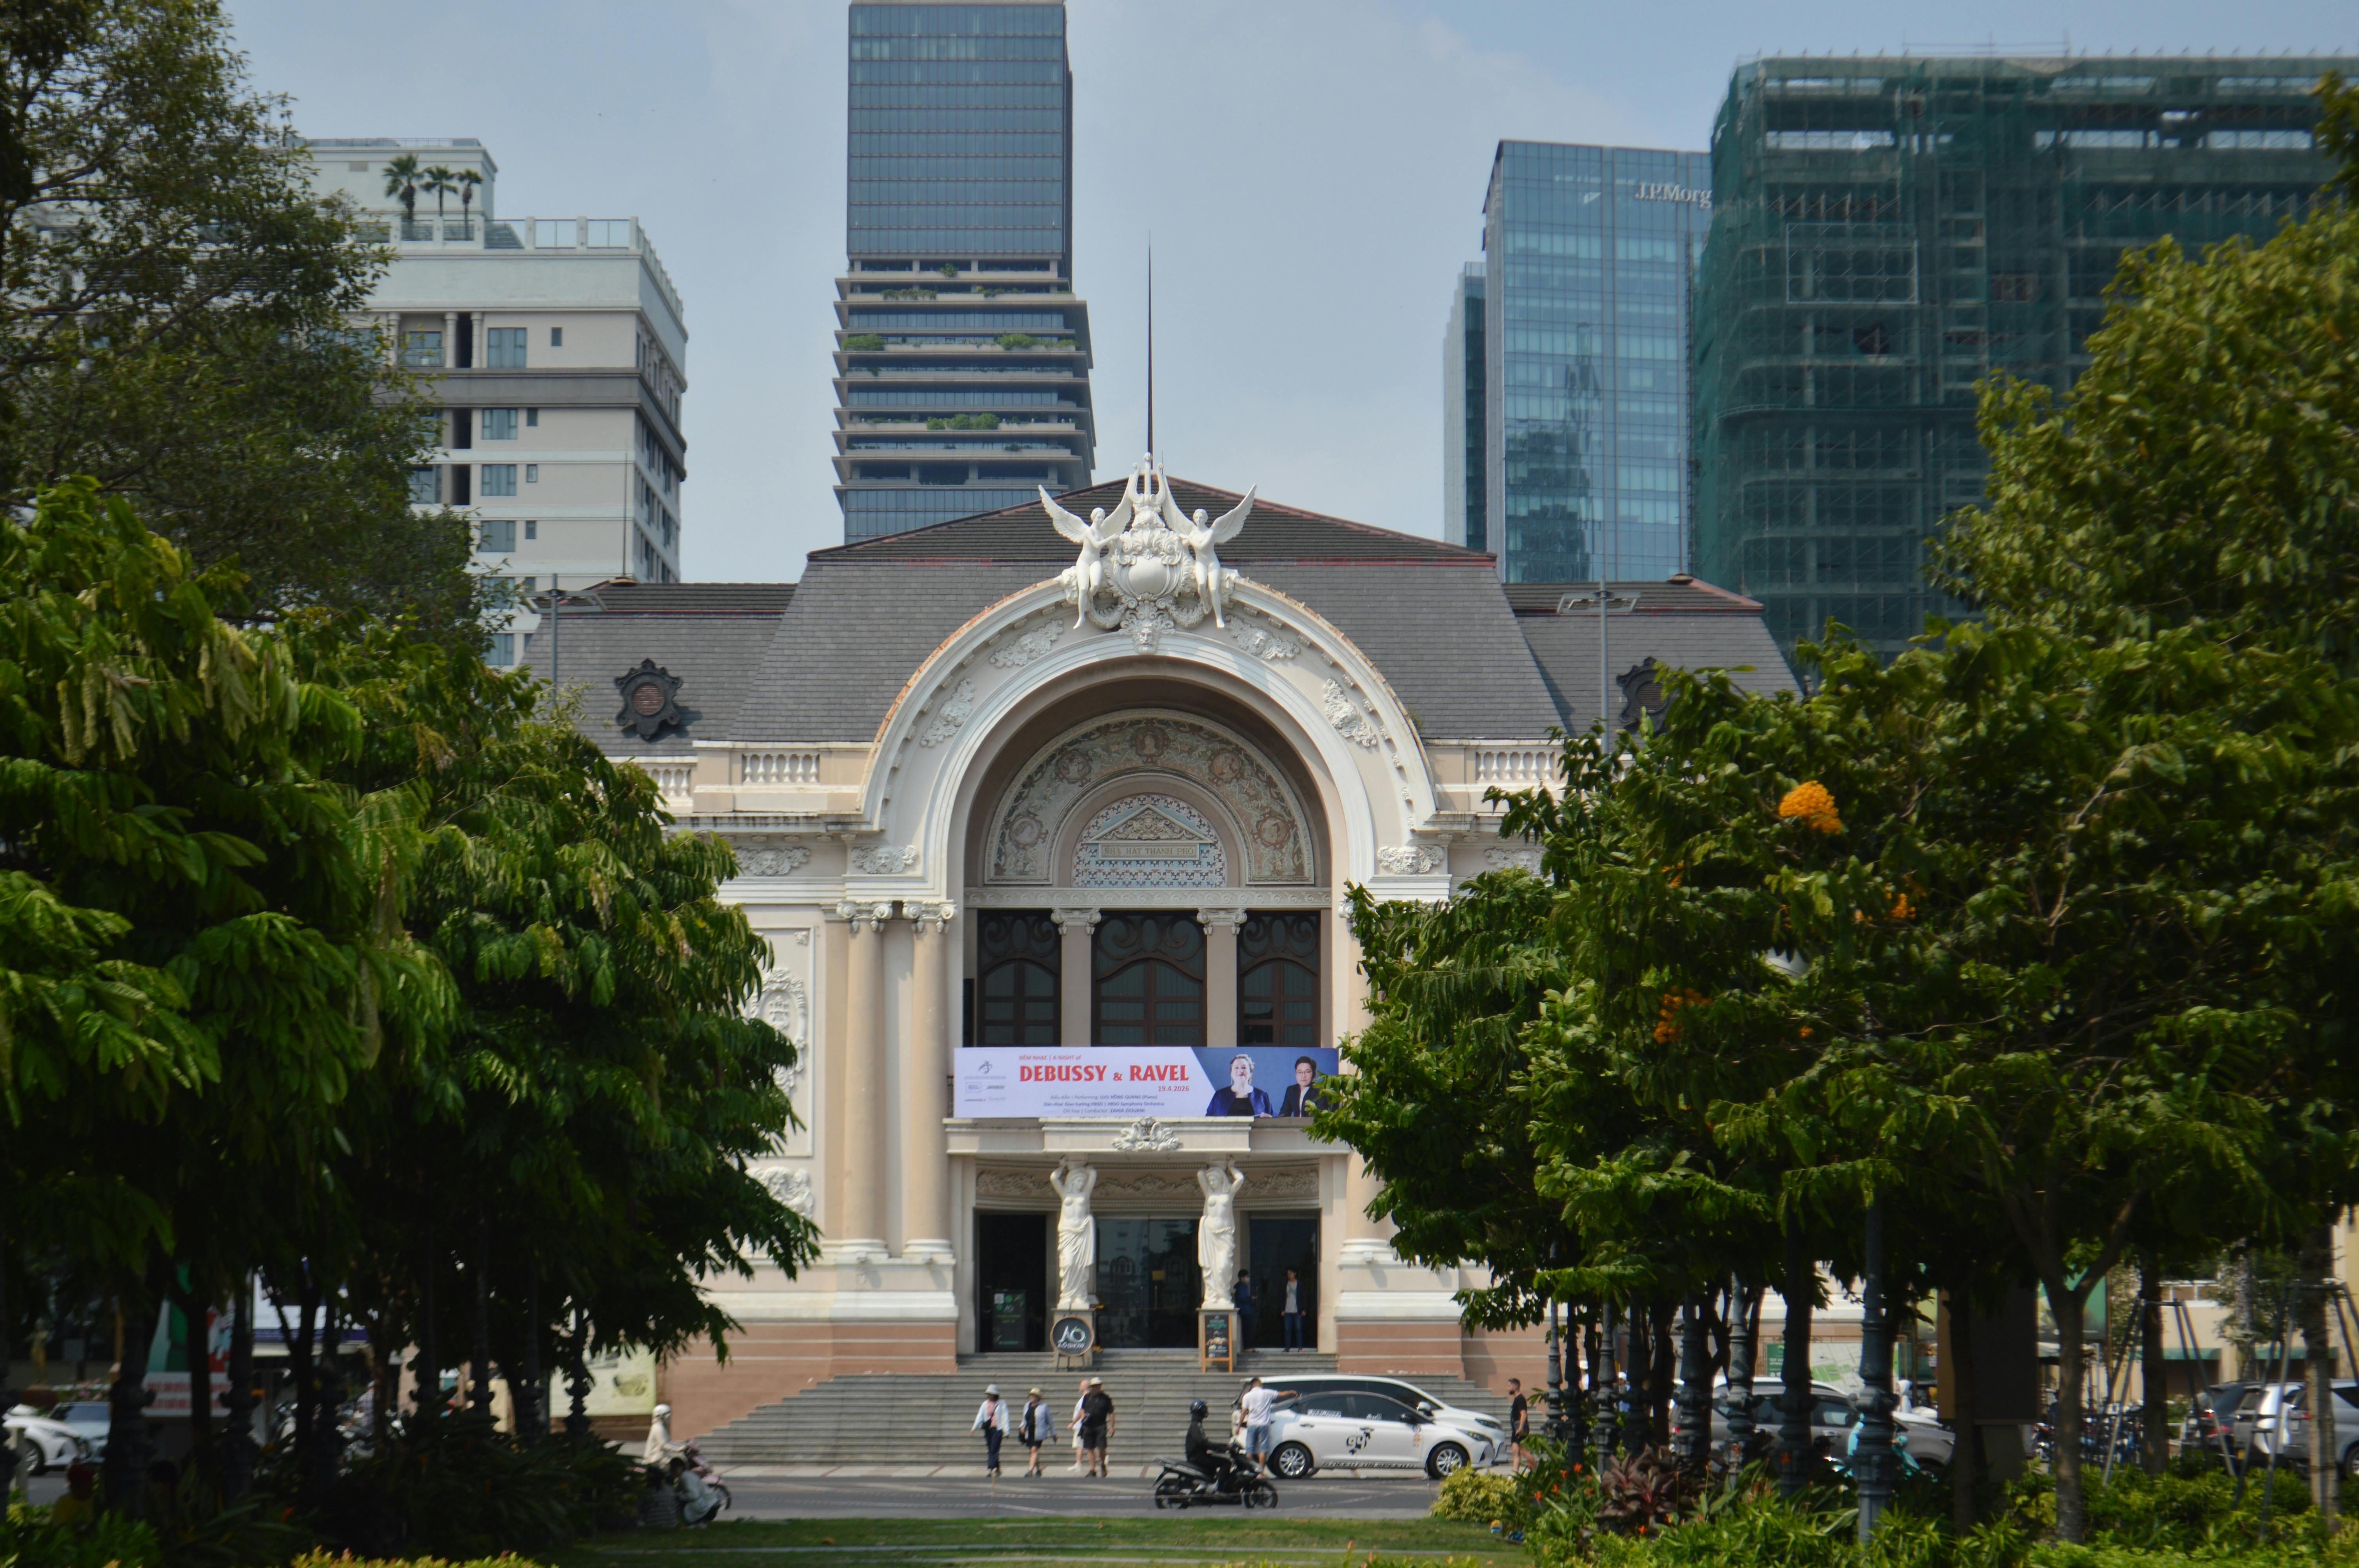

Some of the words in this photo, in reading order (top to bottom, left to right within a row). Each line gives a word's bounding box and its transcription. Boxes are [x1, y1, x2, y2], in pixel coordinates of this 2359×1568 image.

[1020, 1065, 1107, 1082] DEBUSSY
[1113, 1072, 1123, 1082] &
[1129, 1065, 1190, 1082] RAVEL
